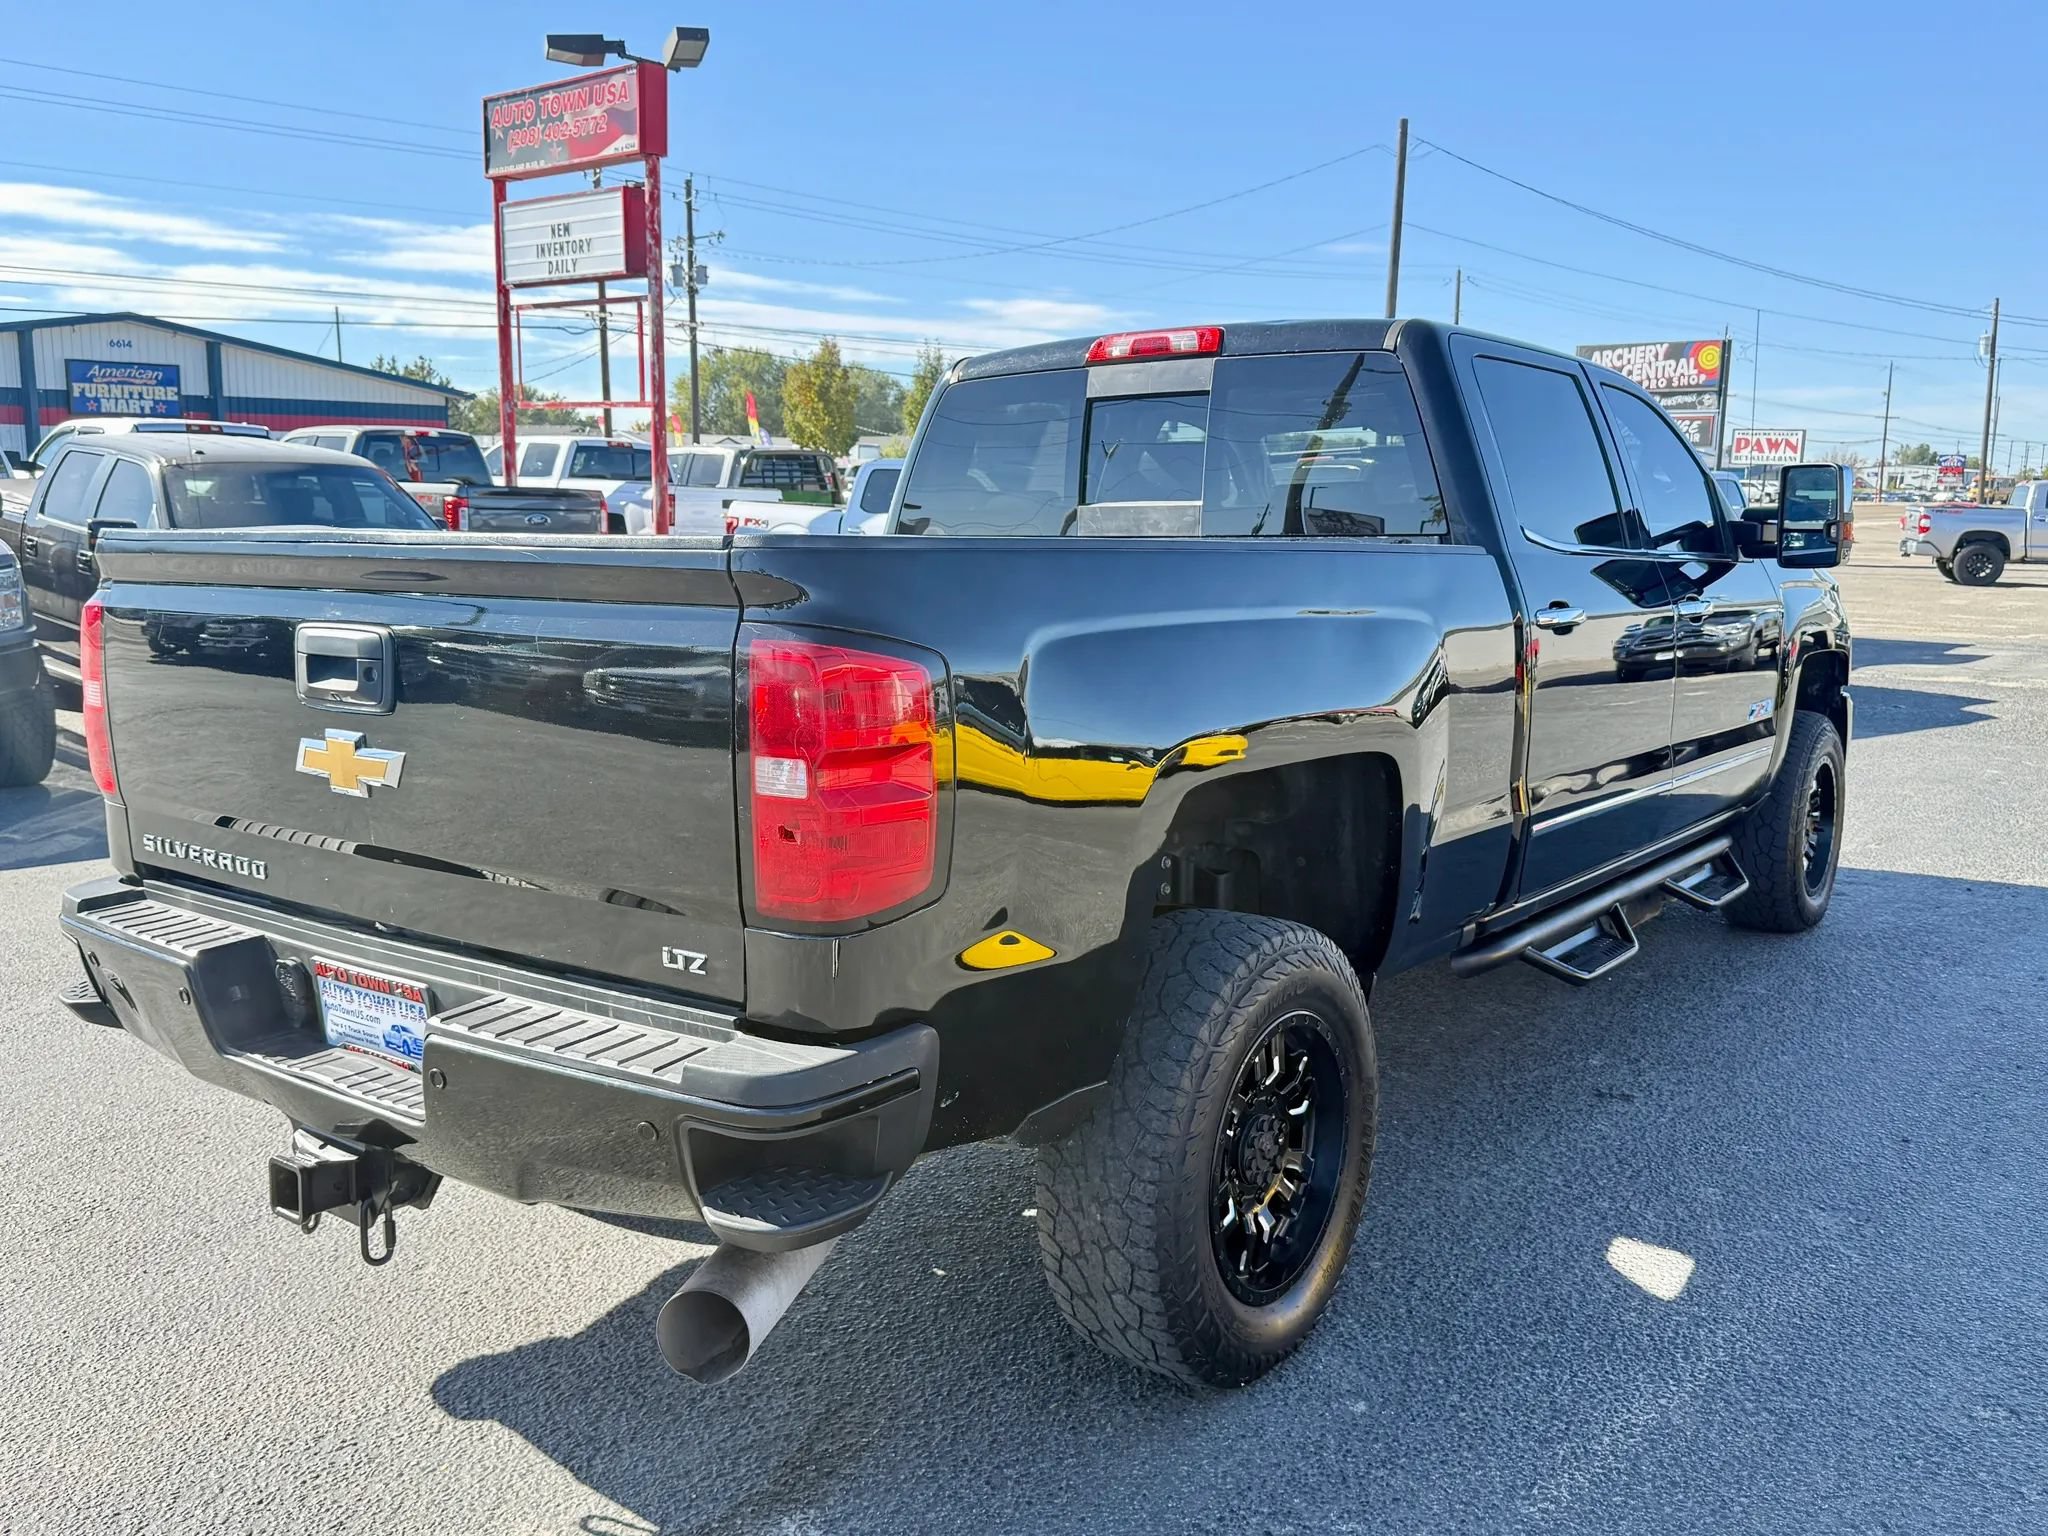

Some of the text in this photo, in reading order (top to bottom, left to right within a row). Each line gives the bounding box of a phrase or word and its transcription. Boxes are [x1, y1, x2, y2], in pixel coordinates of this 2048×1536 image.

[490, 79, 630, 129] AUTO TOWN USA
[507, 113, 608, 153] (208) 402-5772
[550, 222, 571, 239] NEW
[536, 238, 593, 259] INVENTORY
[548, 258, 578, 275] DAILY
[109, 339, 133, 348] 6614
[1591, 343, 1670, 368] ARCHERY
[86, 365, 163, 380] American
[1621, 357, 1698, 381] CENTRAL
[72, 382, 179, 401] FURNITURE
[1642, 374, 1707, 389] PRO SHOP
[100, 399, 153, 414] MART
[1734, 437, 1799, 454] PAWN
[744, 517, 769, 528] FX4
[142, 834, 268, 880] SILVERADO
[662, 946, 708, 975] LTZ
[314, 961, 425, 1003] AUTO TOWN USA
[321, 980, 427, 1023] AUTO TOWN USA
